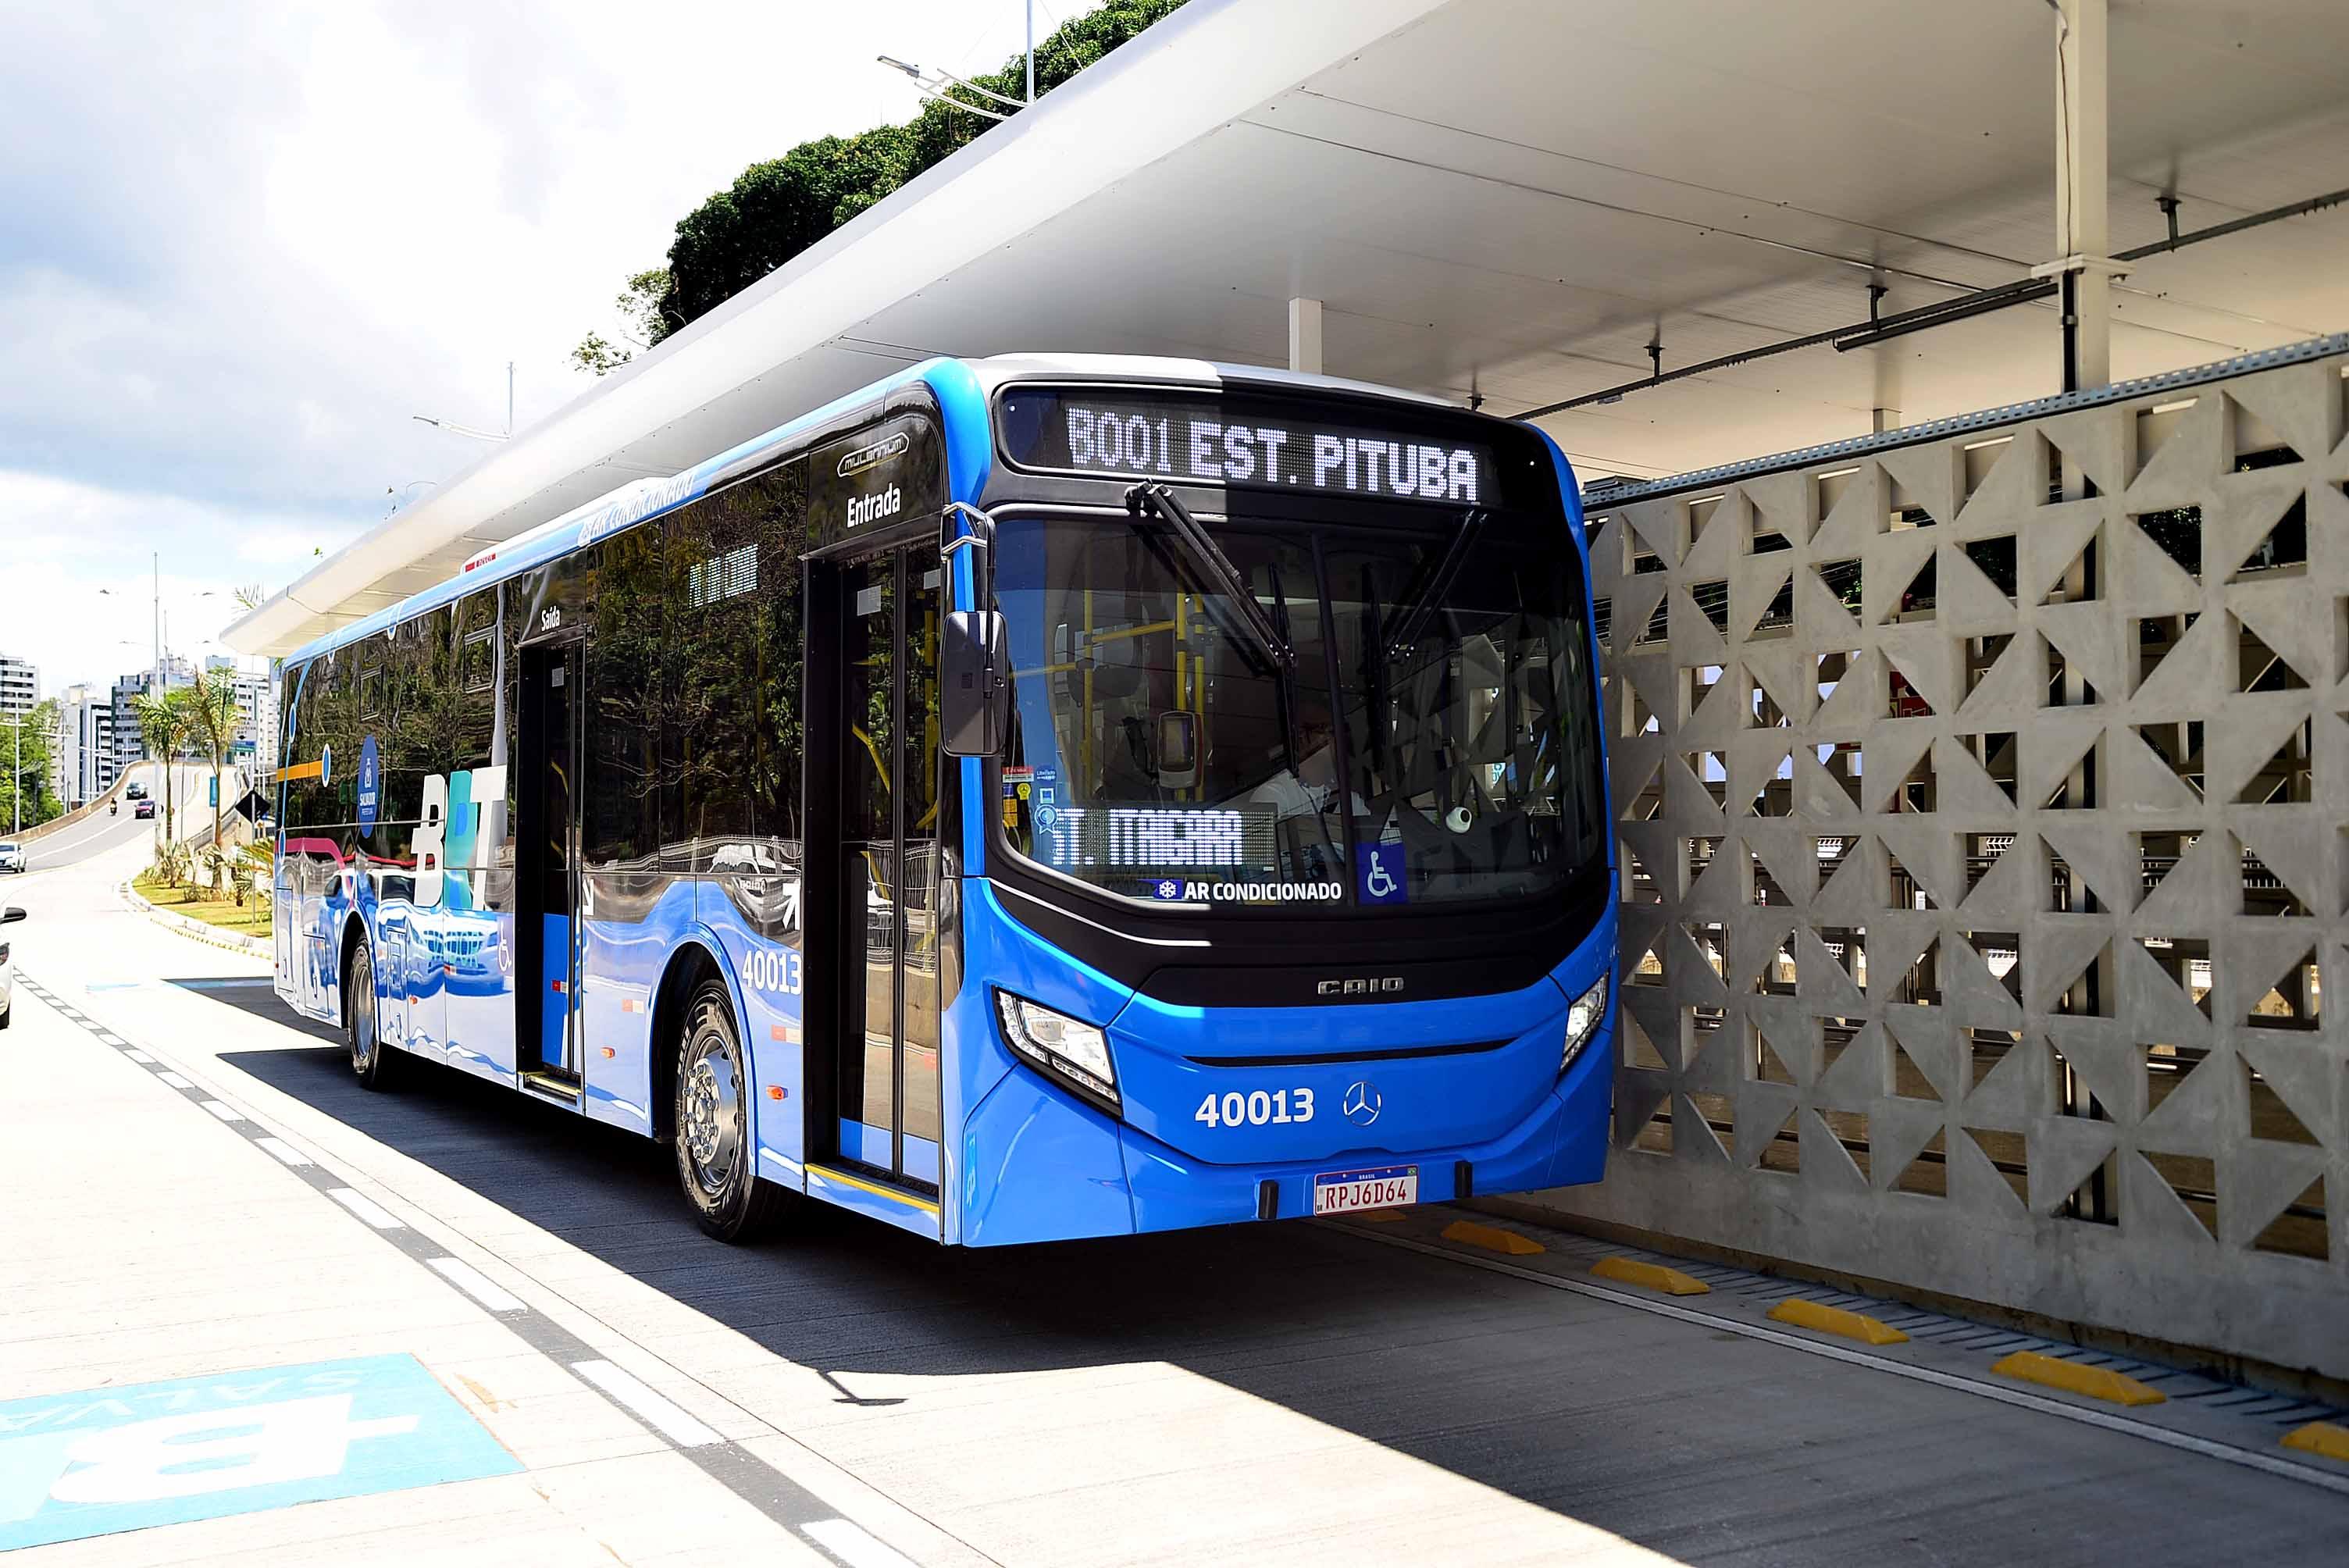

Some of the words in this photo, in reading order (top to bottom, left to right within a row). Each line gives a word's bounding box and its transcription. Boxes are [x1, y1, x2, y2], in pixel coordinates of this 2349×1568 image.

[1068, 408, 1171, 472] B001
[1190, 420, 1296, 484] EST.
[1314, 433, 1477, 501] PITUBA
[847, 482, 901, 528] Entrada
[541, 605, 561, 631] Saída
[411, 764, 507, 911] BRT
[1184, 882, 1210, 900] AR
[1213, 882, 1342, 900] CONDICIONADO
[742, 950, 802, 995] 40013
[1317, 977, 1405, 995] CAIO
[1195, 1088, 1315, 1128] 40013
[1325, 1180, 1406, 1210] RPJ6D64
